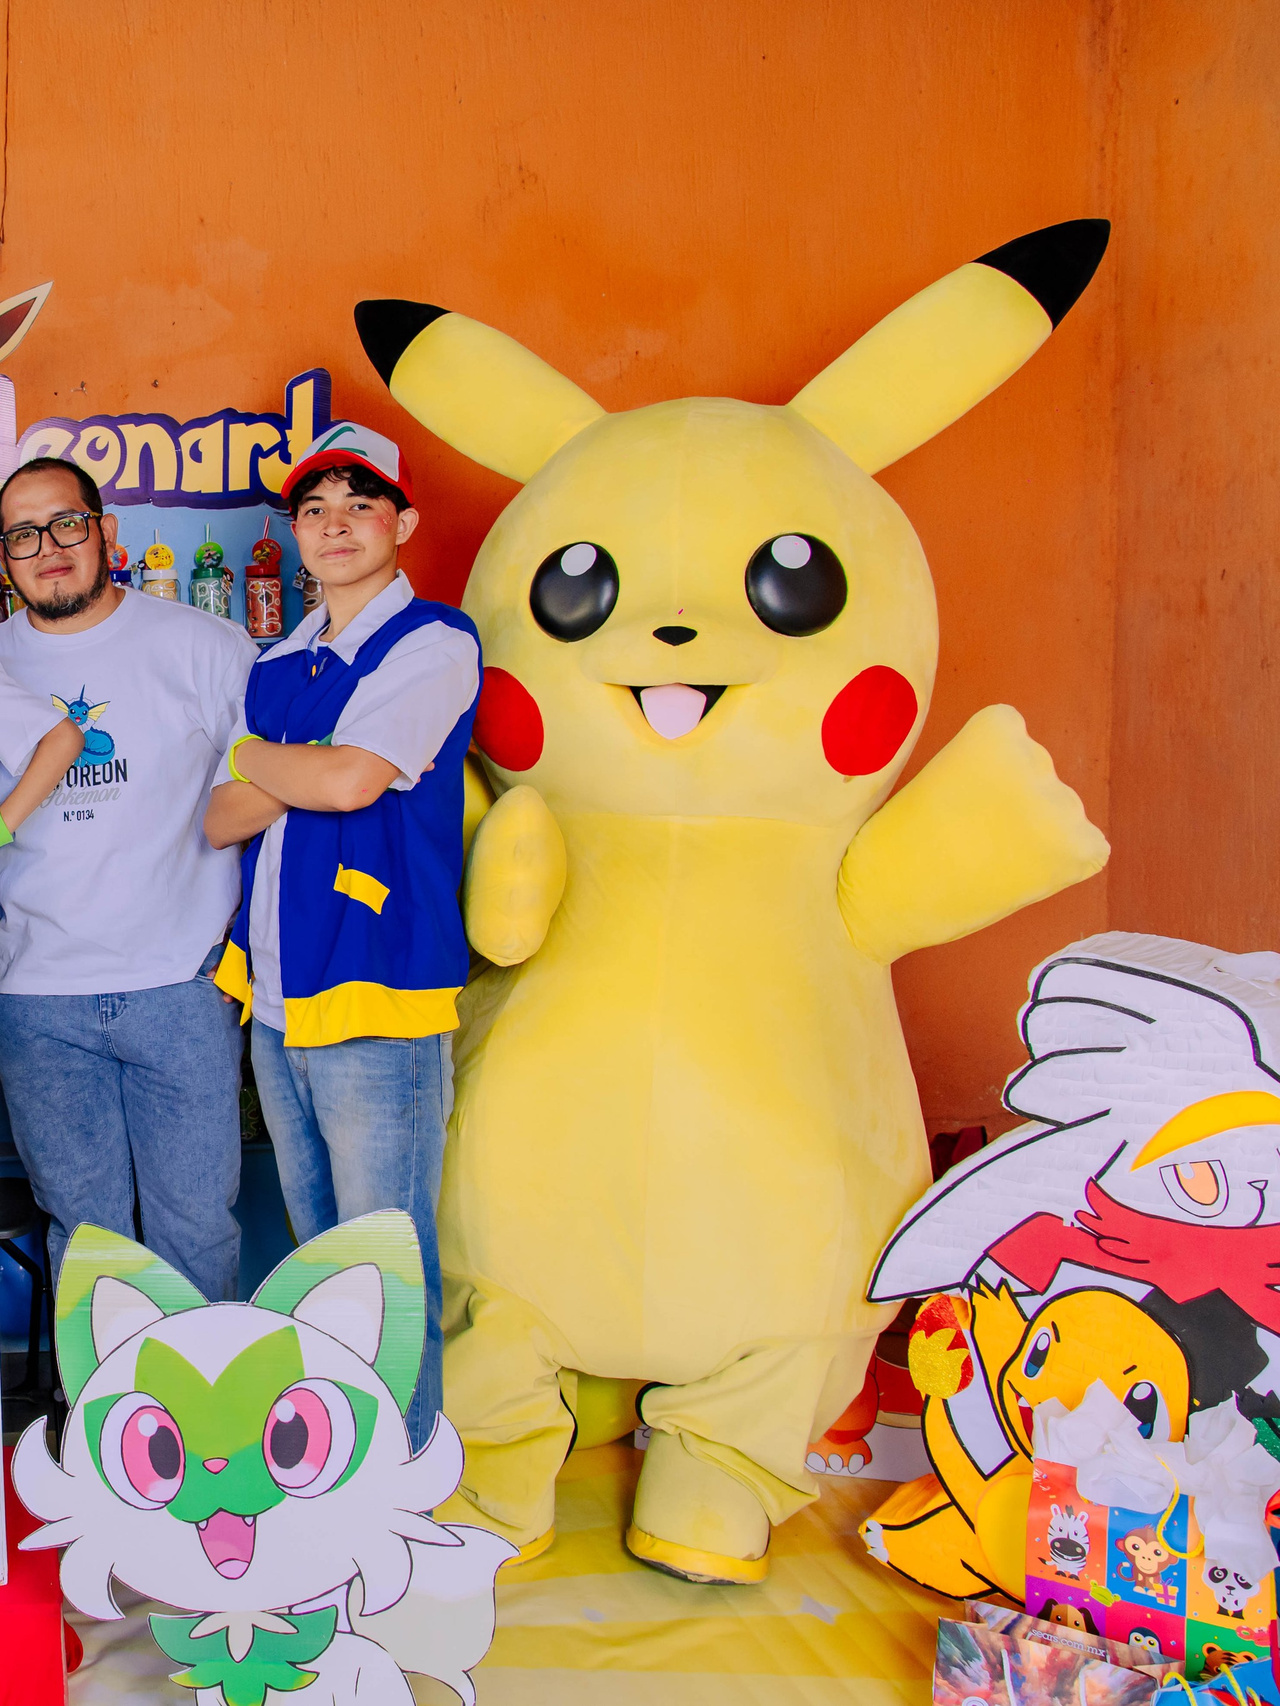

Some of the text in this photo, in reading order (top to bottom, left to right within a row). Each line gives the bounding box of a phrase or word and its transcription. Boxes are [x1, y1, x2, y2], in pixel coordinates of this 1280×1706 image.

[53, 758, 127, 790] OREON
[76, 809, 95, 821] 0134
[1031, 1629, 1106, 1657] sears.com.mx
